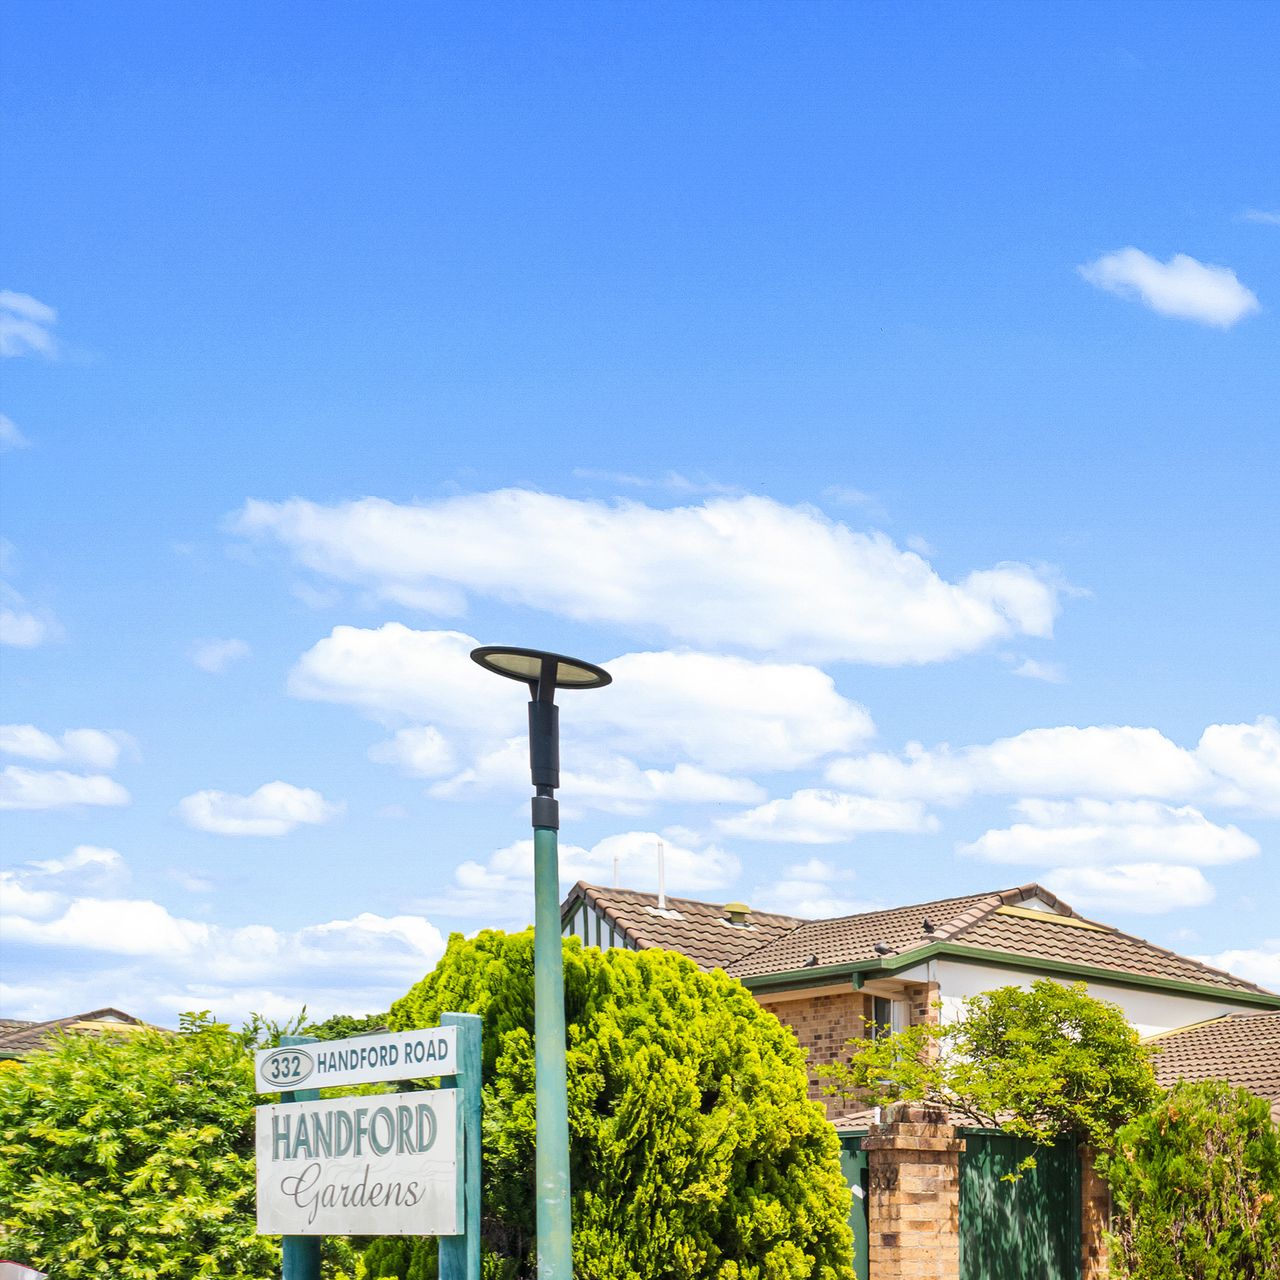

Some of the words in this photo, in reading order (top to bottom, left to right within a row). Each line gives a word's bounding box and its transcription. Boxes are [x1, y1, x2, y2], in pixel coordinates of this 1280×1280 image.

[271, 1055, 301, 1080] 332
[317, 1043, 399, 1074] HANDFORD
[404, 1038, 448, 1065] ROAD
[271, 1103, 438, 1161] HANDFORD
[280, 1162, 427, 1225] Gardens
